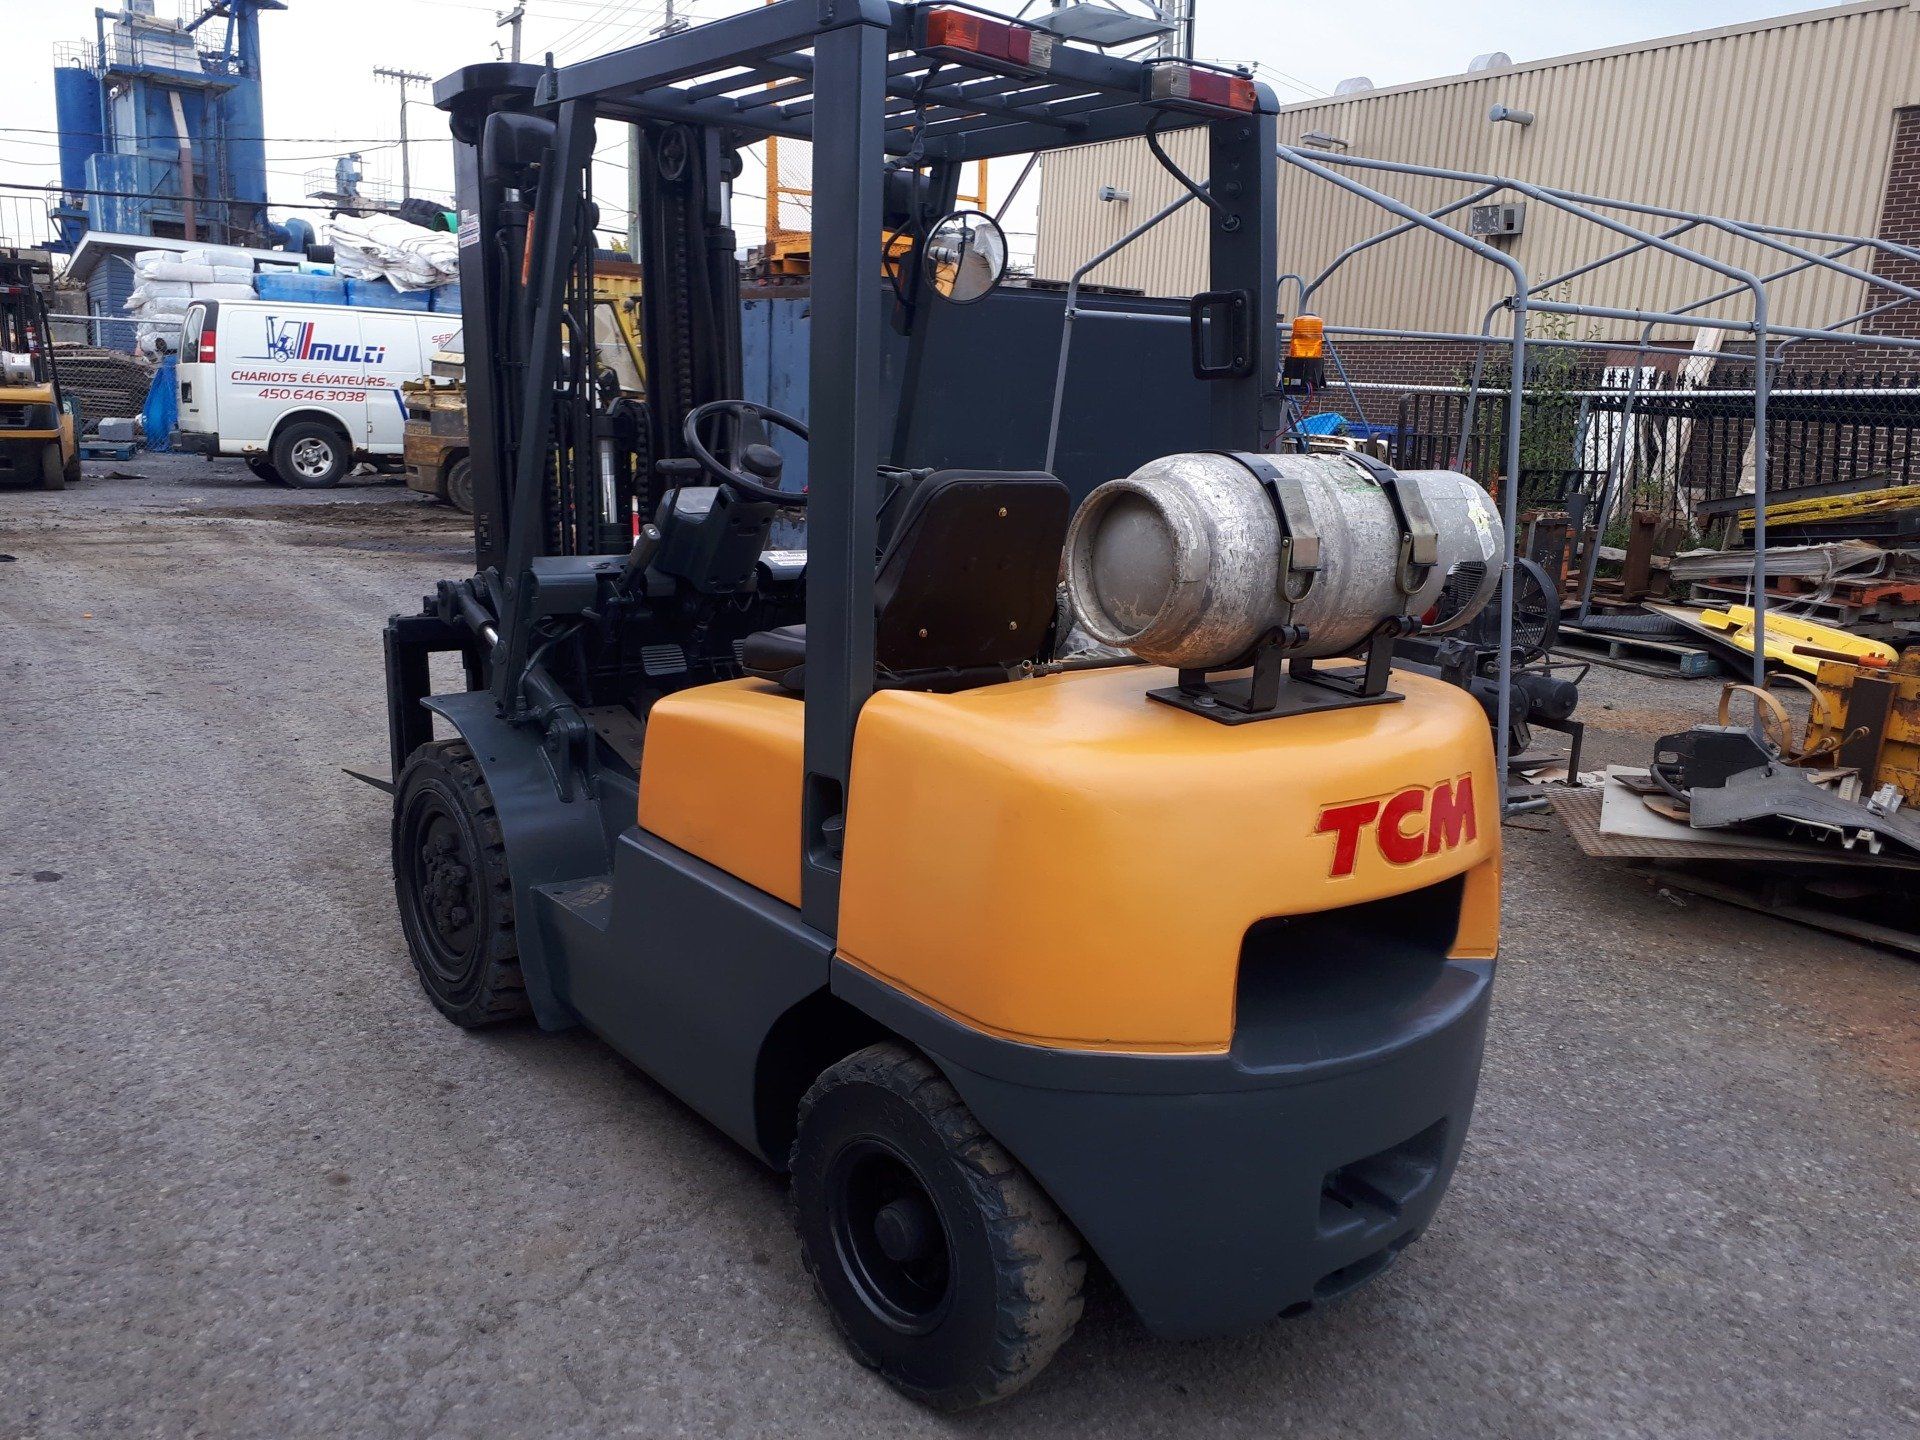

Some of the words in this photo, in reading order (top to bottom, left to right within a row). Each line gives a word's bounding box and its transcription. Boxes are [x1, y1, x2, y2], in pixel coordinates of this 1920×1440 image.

[431, 333, 453, 343] SER
[231, 370, 298, 383] CHARIOTS
[301, 372, 387, 387] ÉLÉVATEURS
[258, 388, 367, 403] 450.646.3038
[1317, 776, 1477, 876] TCM
